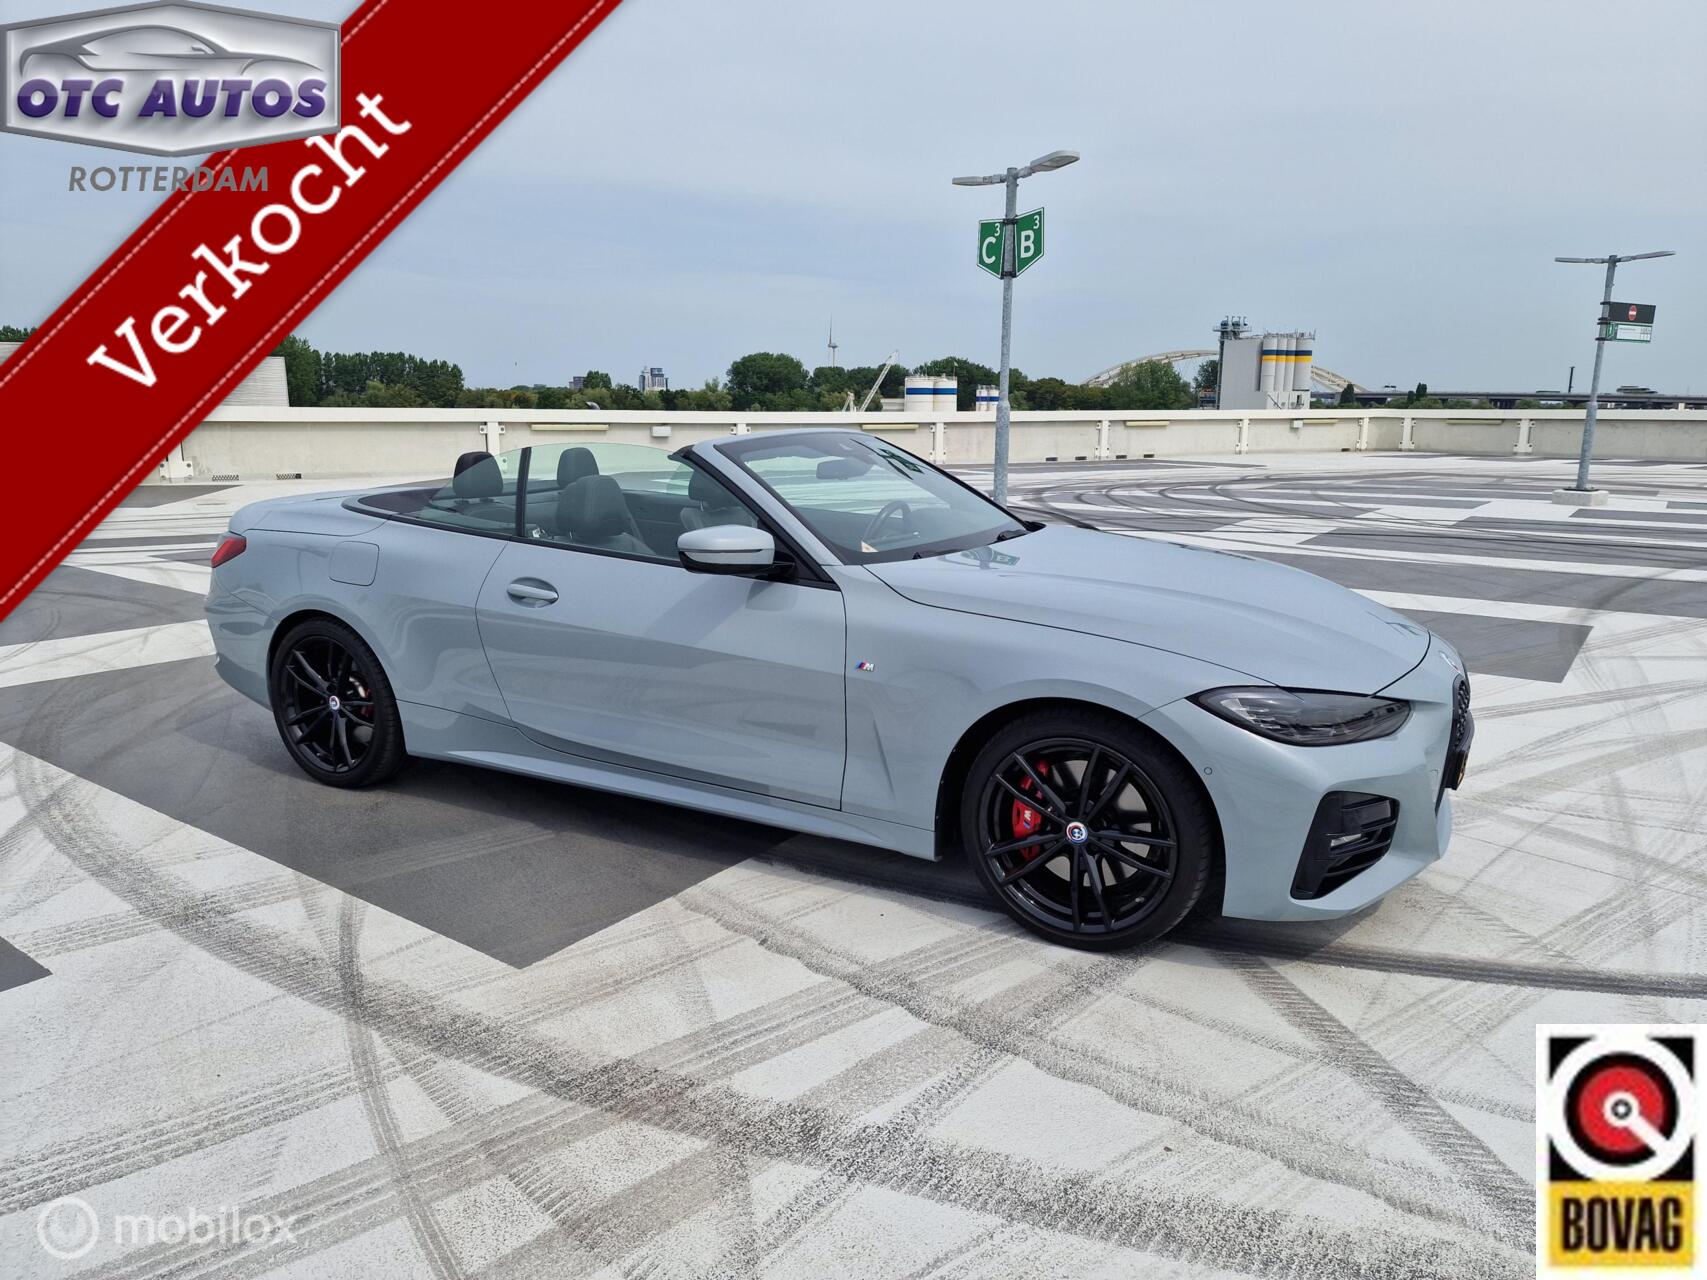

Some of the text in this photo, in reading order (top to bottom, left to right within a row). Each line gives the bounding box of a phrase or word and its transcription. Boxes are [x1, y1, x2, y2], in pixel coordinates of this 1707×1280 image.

[994, 222, 1001, 237] 3
[1033, 215, 1040, 230] 3
[981, 236, 997, 265] C
[1020, 229, 1035, 259] B
